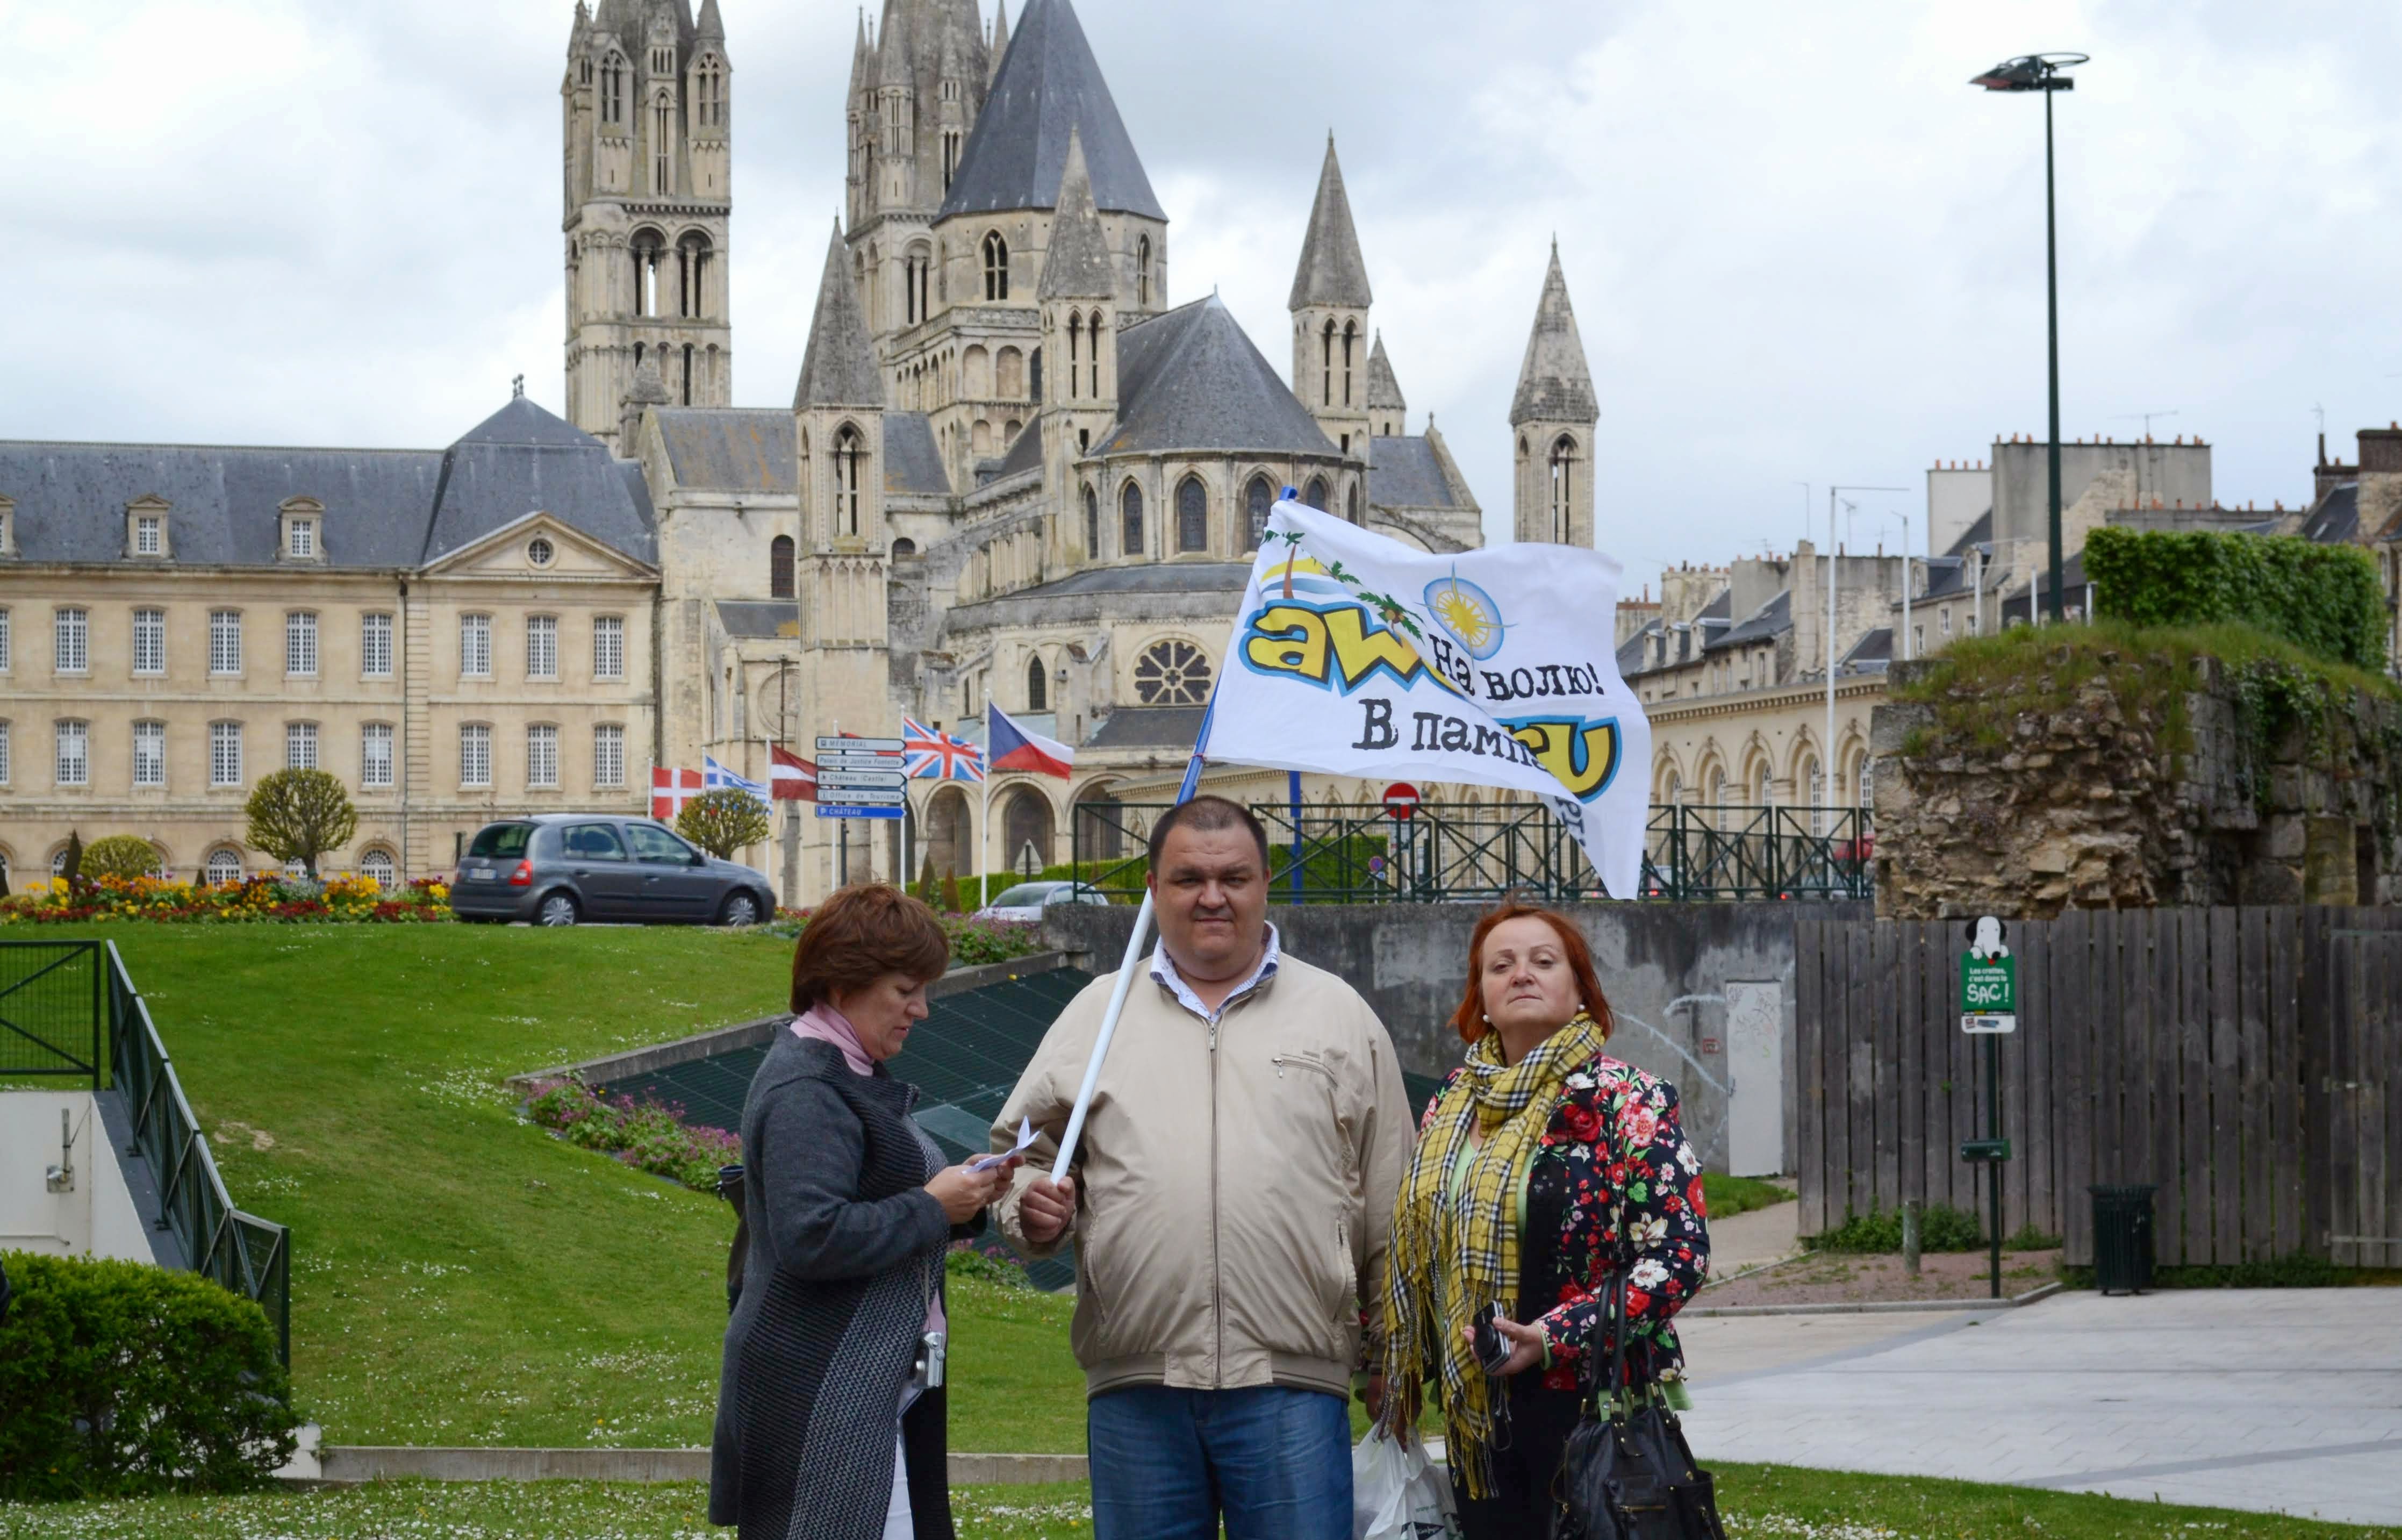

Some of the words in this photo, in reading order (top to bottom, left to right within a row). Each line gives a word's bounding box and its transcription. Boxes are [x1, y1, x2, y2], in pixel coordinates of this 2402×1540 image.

[1428, 633, 1475, 697] На
[1480, 662, 1604, 701] волю!
[1351, 698, 1399, 750] В
[829, 791, 851, 799] Office
